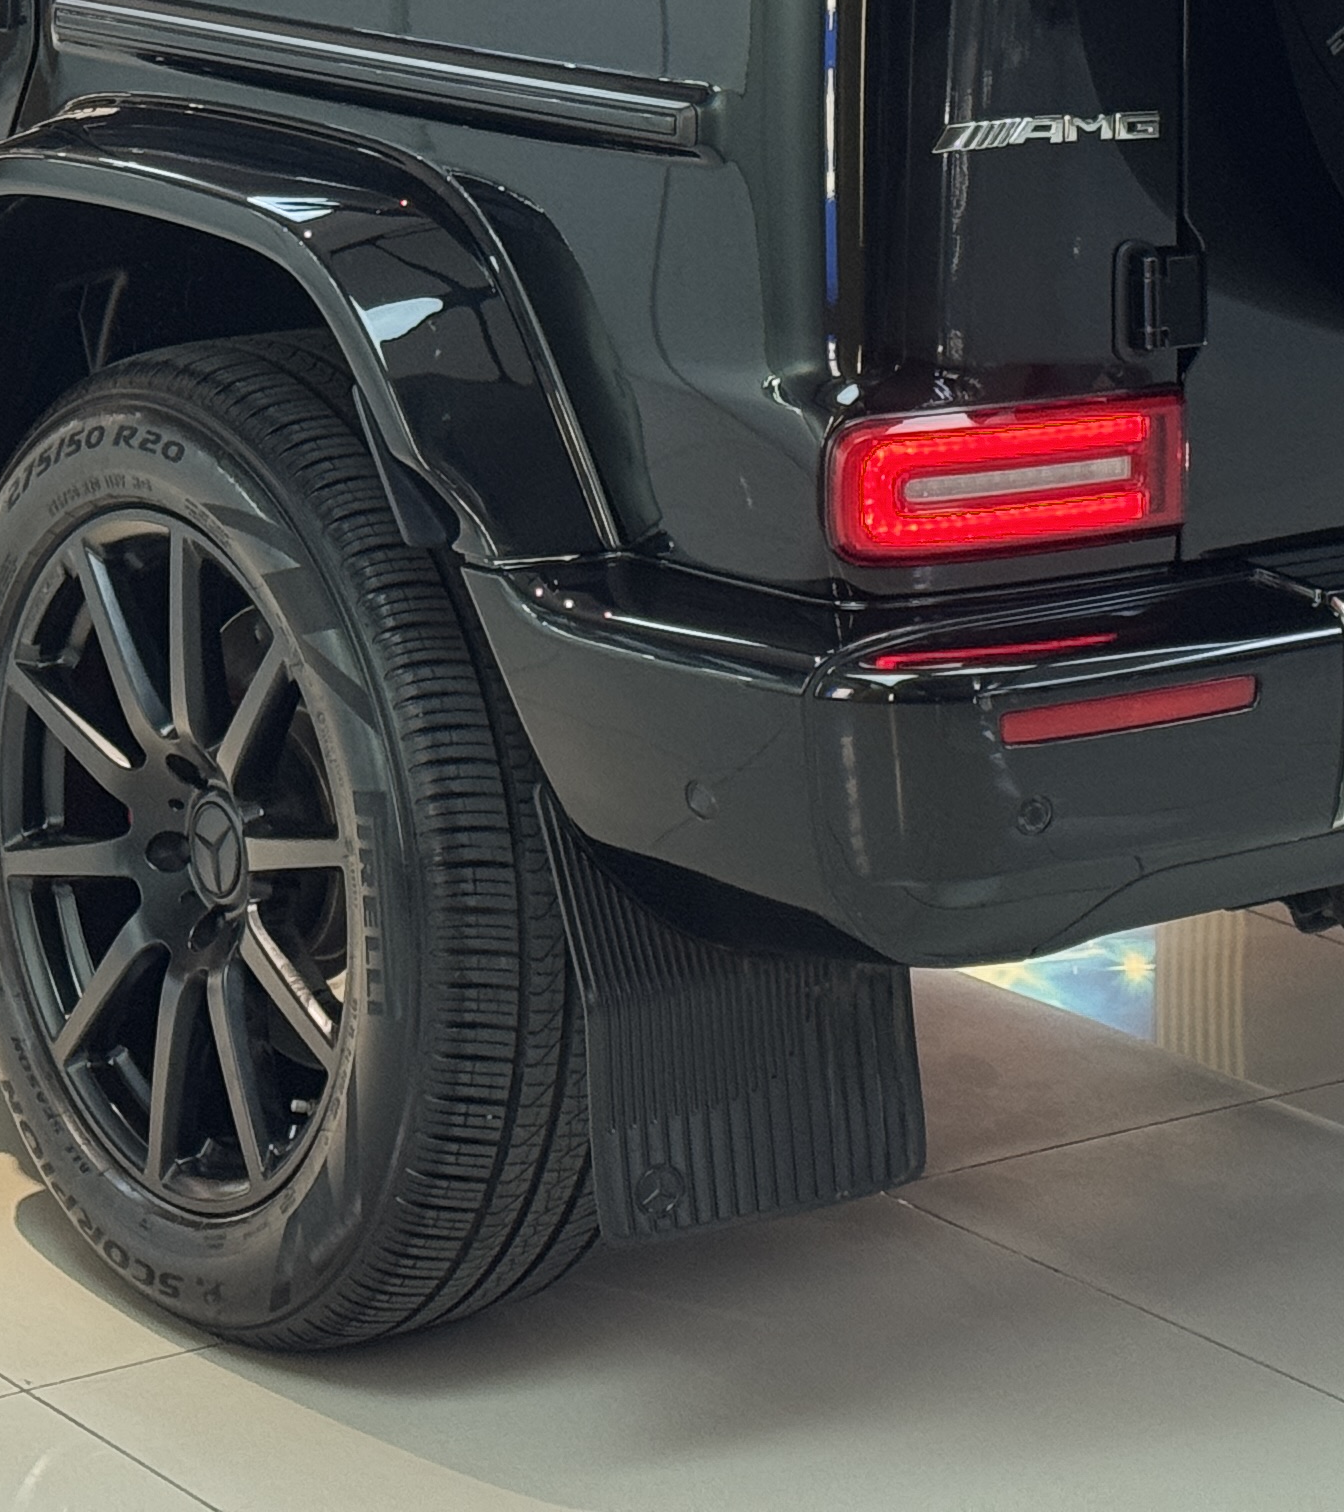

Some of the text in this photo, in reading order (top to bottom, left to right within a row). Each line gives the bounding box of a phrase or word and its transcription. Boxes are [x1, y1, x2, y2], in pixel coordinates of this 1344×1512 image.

[1010, 111, 1159, 144] AMG
[5, 425, 105, 513] 275/50
[112, 424, 186, 464] R20
[0, 1078, 184, 1300] SCORPION
